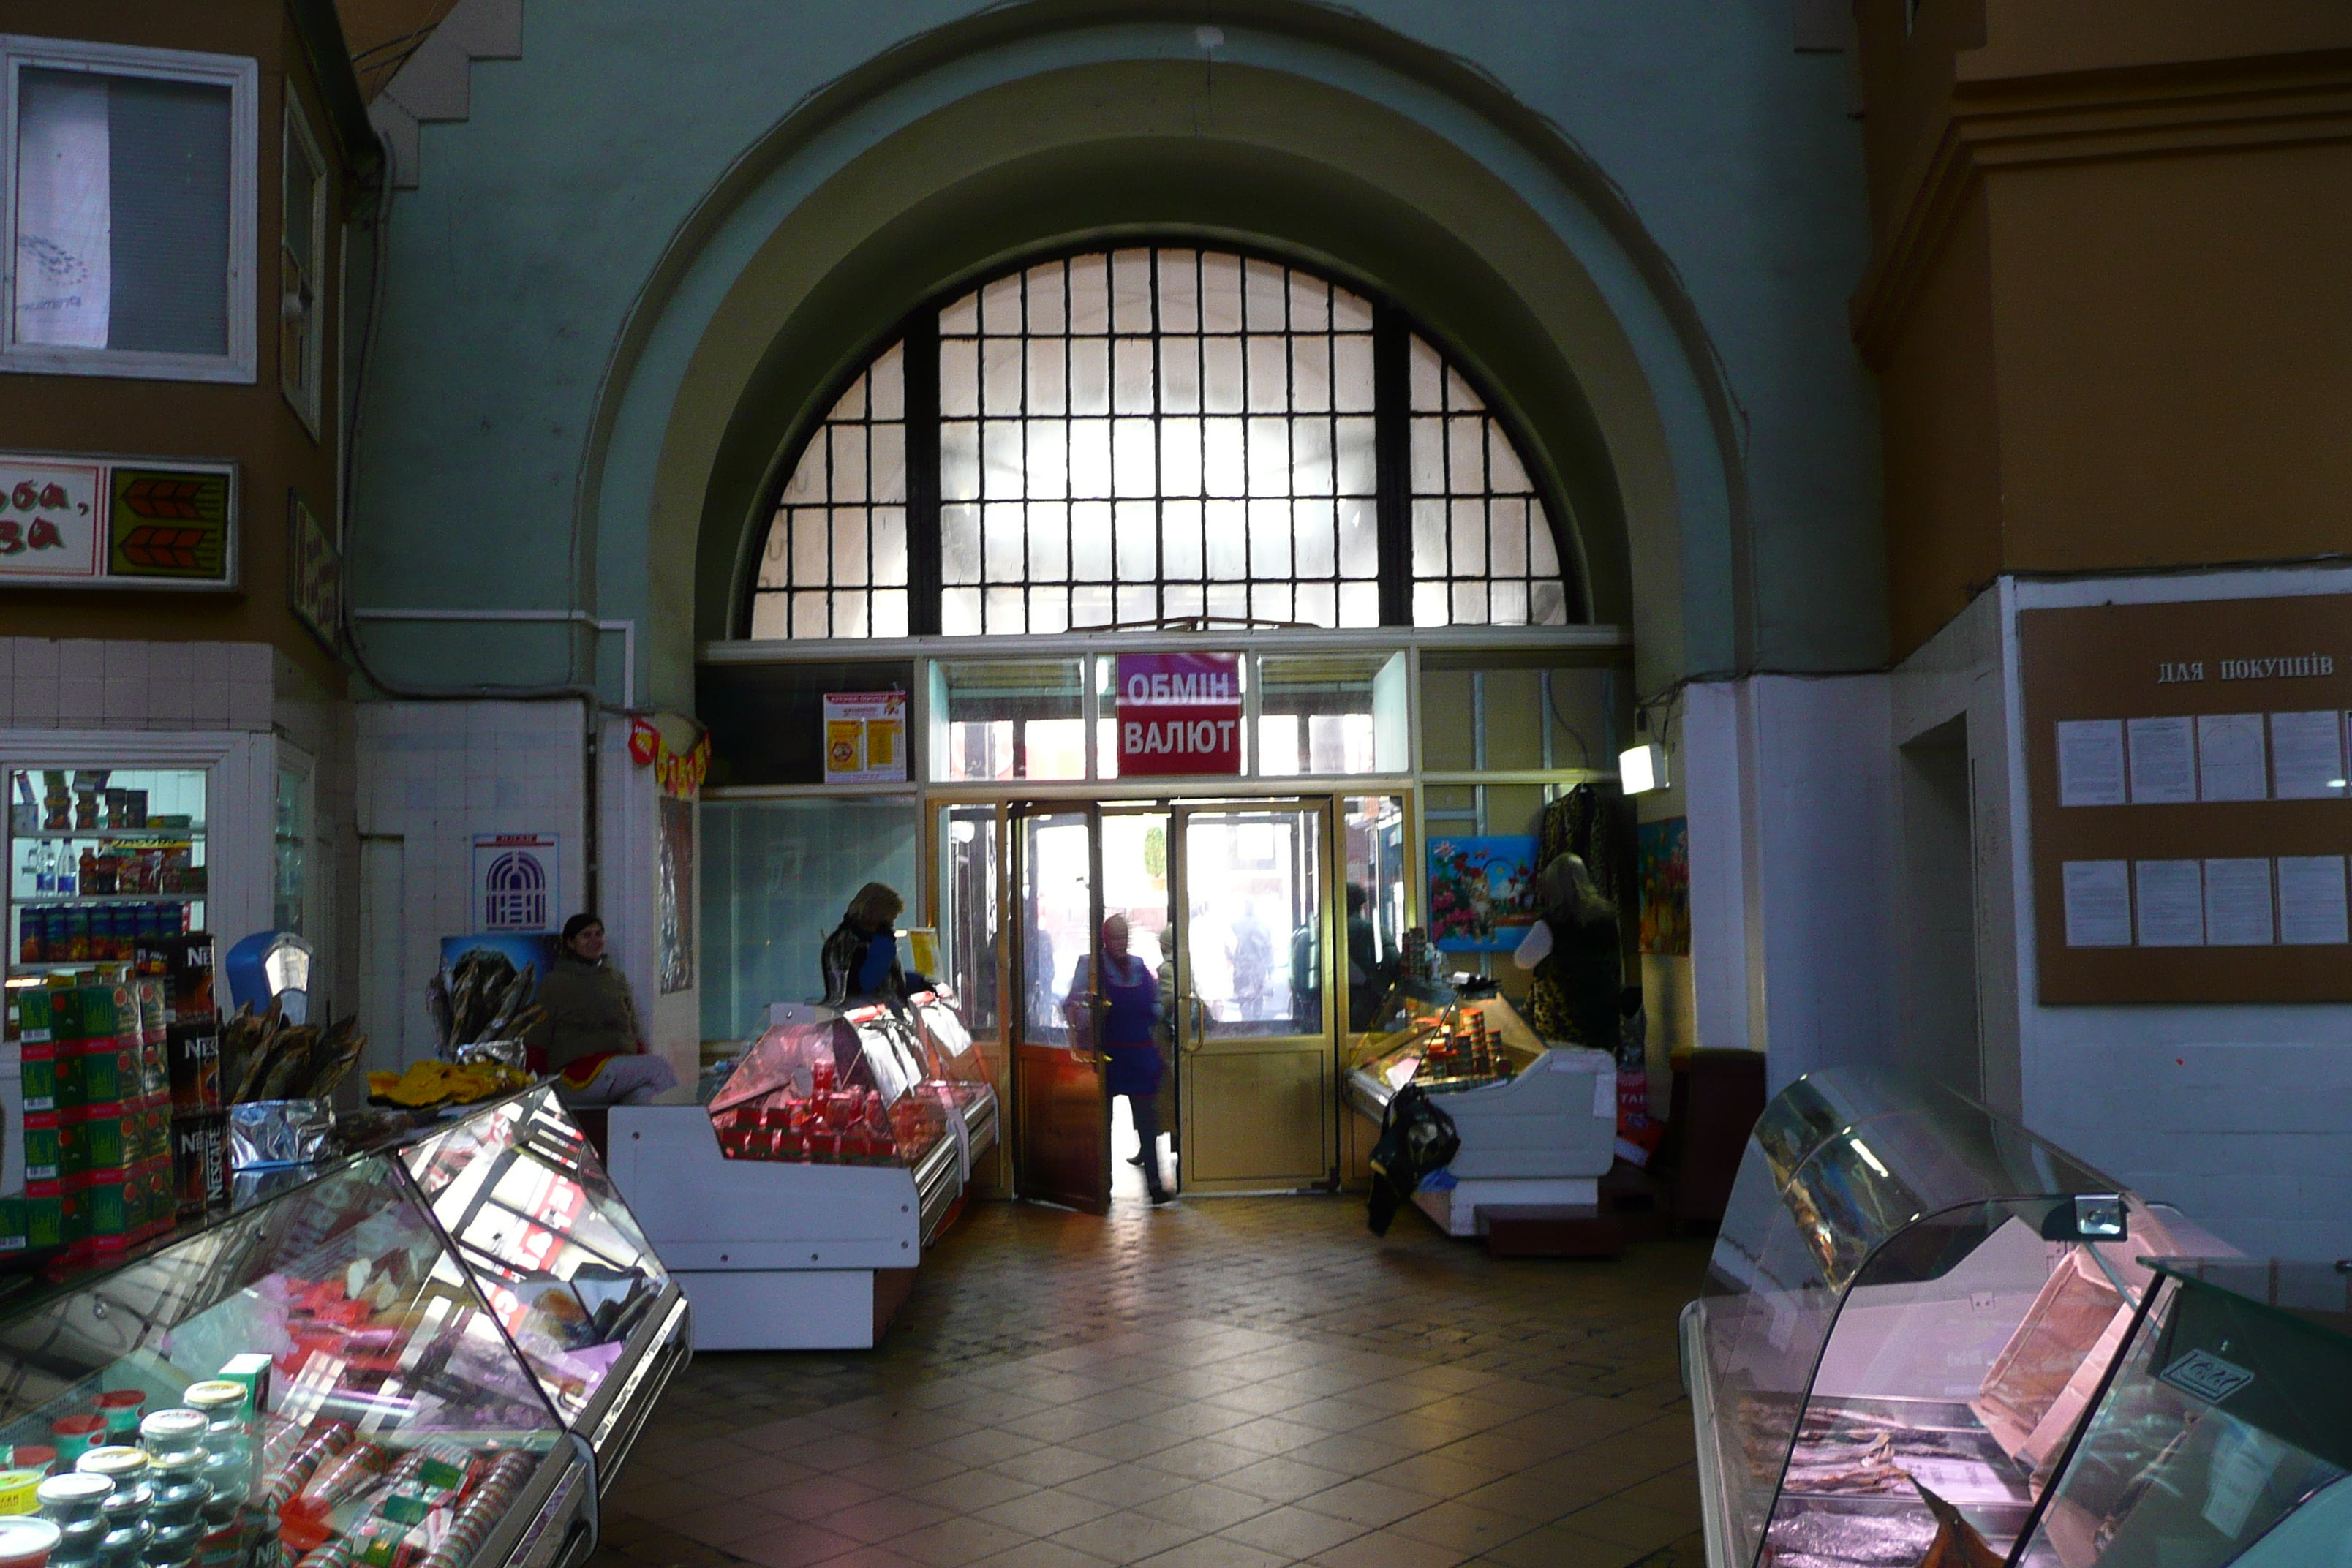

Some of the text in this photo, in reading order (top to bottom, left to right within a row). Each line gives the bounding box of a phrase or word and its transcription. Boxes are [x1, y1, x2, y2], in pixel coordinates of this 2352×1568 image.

[2157, 661, 2205, 684] ДЛЯ
[1128, 673, 1229, 706] ОБМІН
[1124, 719, 1235, 755] ВАЛЮТ
